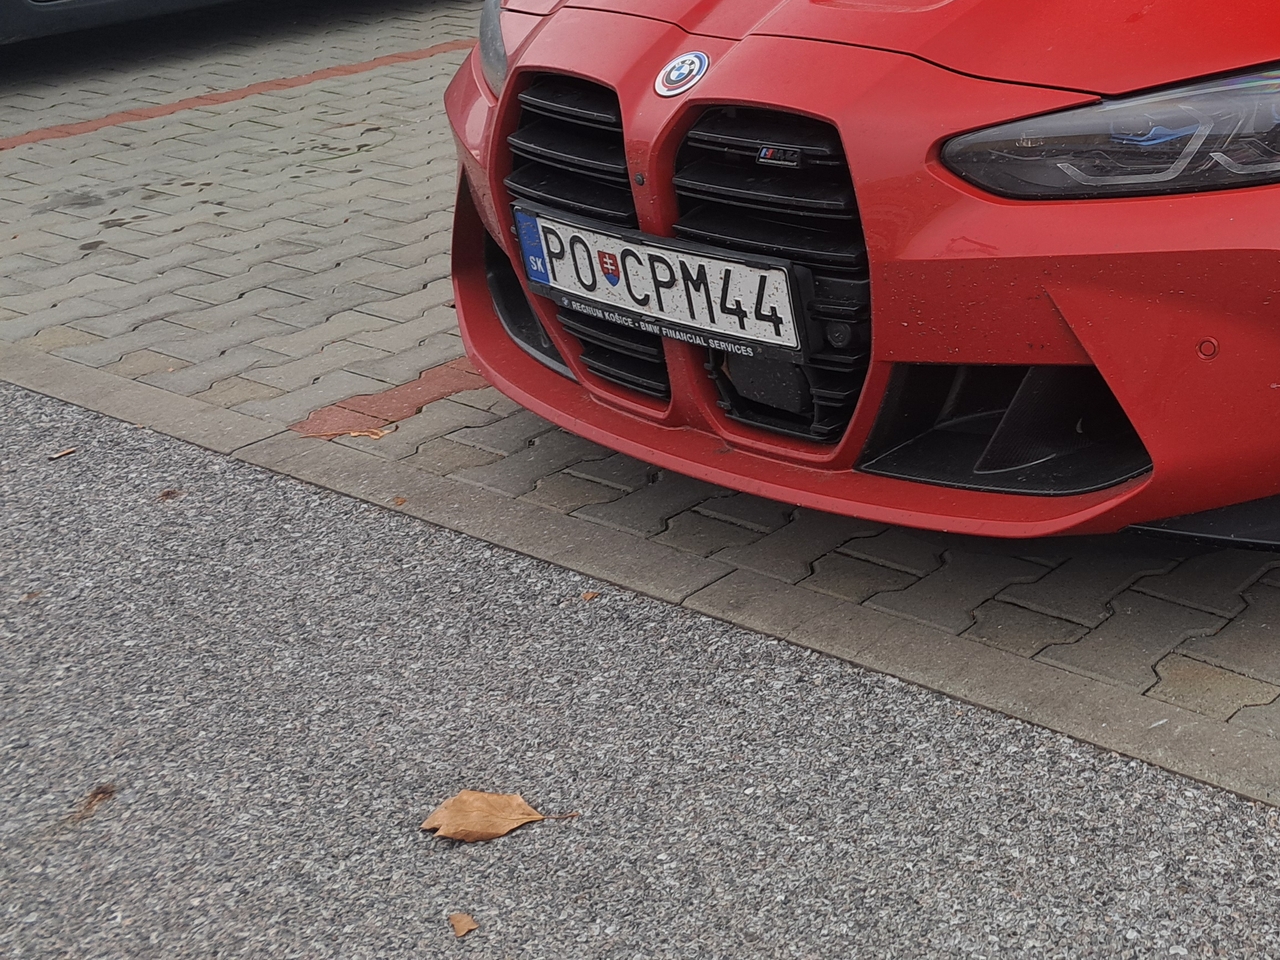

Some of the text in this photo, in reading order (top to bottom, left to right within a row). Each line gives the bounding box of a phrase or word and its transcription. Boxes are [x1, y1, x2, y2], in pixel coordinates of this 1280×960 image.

[529, 255, 545, 274] SK
[541, 225, 784, 337] PO CPM44
[571, 300, 754, 357] REGNUM KOŠICE BMW FINANCIAL SERVICES
